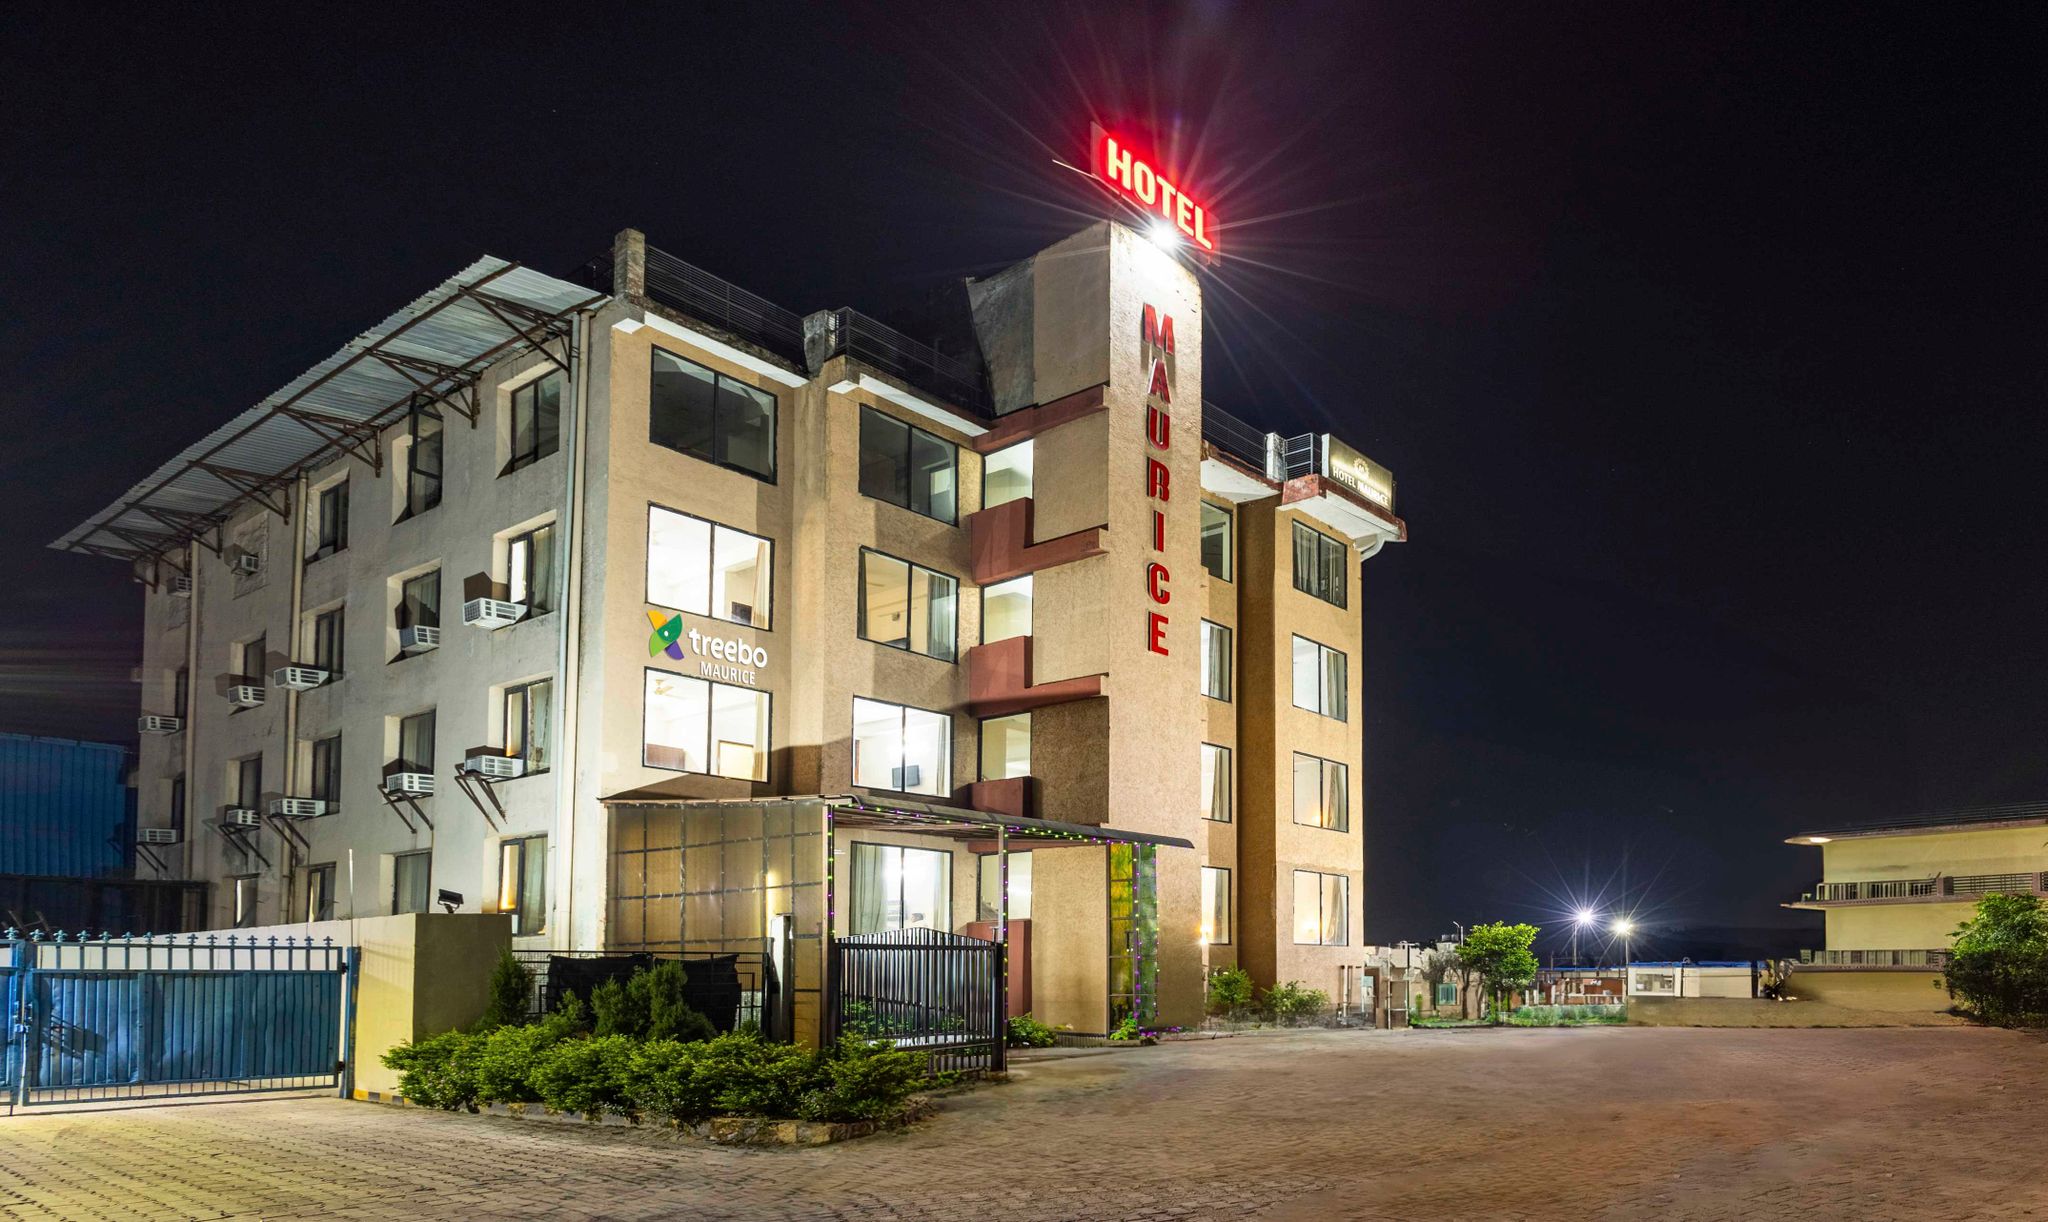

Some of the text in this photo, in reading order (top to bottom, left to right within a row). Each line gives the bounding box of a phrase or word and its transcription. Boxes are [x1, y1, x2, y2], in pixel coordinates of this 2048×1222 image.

[1107, 138, 1212, 250] HOTEL
[1143, 303, 1175, 656] MAURICE
[1332, 466, 1356, 488] HOTEL
[688, 627, 768, 668] treebo
[700, 661, 756, 685] MAURICE
